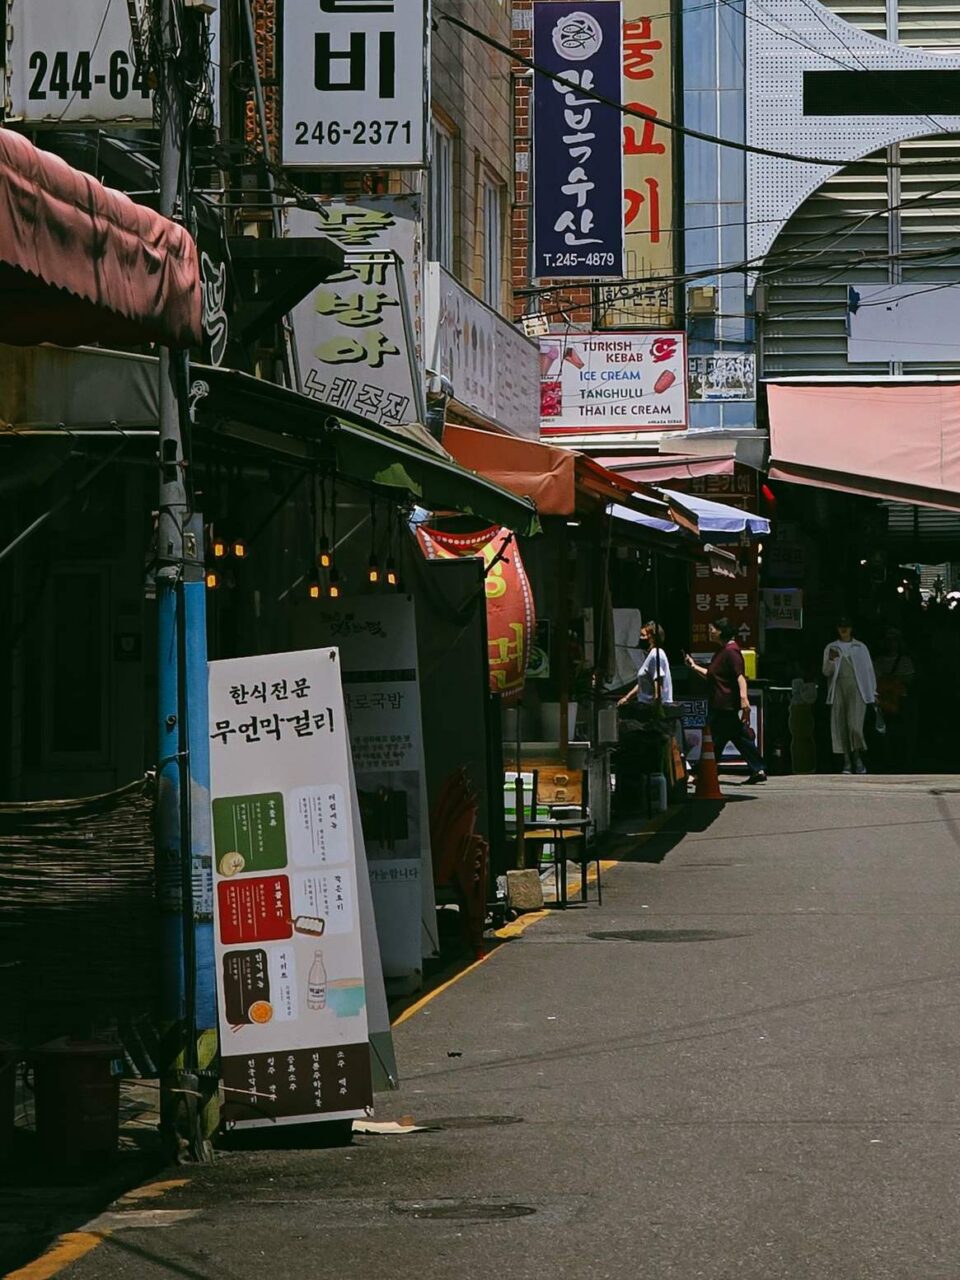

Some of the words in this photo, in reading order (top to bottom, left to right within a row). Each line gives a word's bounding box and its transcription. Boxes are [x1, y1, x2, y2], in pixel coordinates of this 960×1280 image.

[28, 50, 151, 101] 244-64
[294, 120, 412, 146] 246-2371
[552, 68, 604, 246] 만복수산
[543, 252, 615, 268] T.245-4879
[583, 341, 632, 352] TURKISH
[606, 353, 644, 363] KEBAB
[579, 371, 597, 381] ICE
[600, 371, 641, 381] CREAM
[579, 389, 643, 400] TANGHULU
[578, 406, 606, 417] THAI
[610, 406, 627, 416] ICE
[630, 405, 672, 416] CREAM
[696, 593, 749, 612] 탕후루
[229, 677, 311, 705] 한식전문
[210, 707, 335, 745] 무언막걸리
